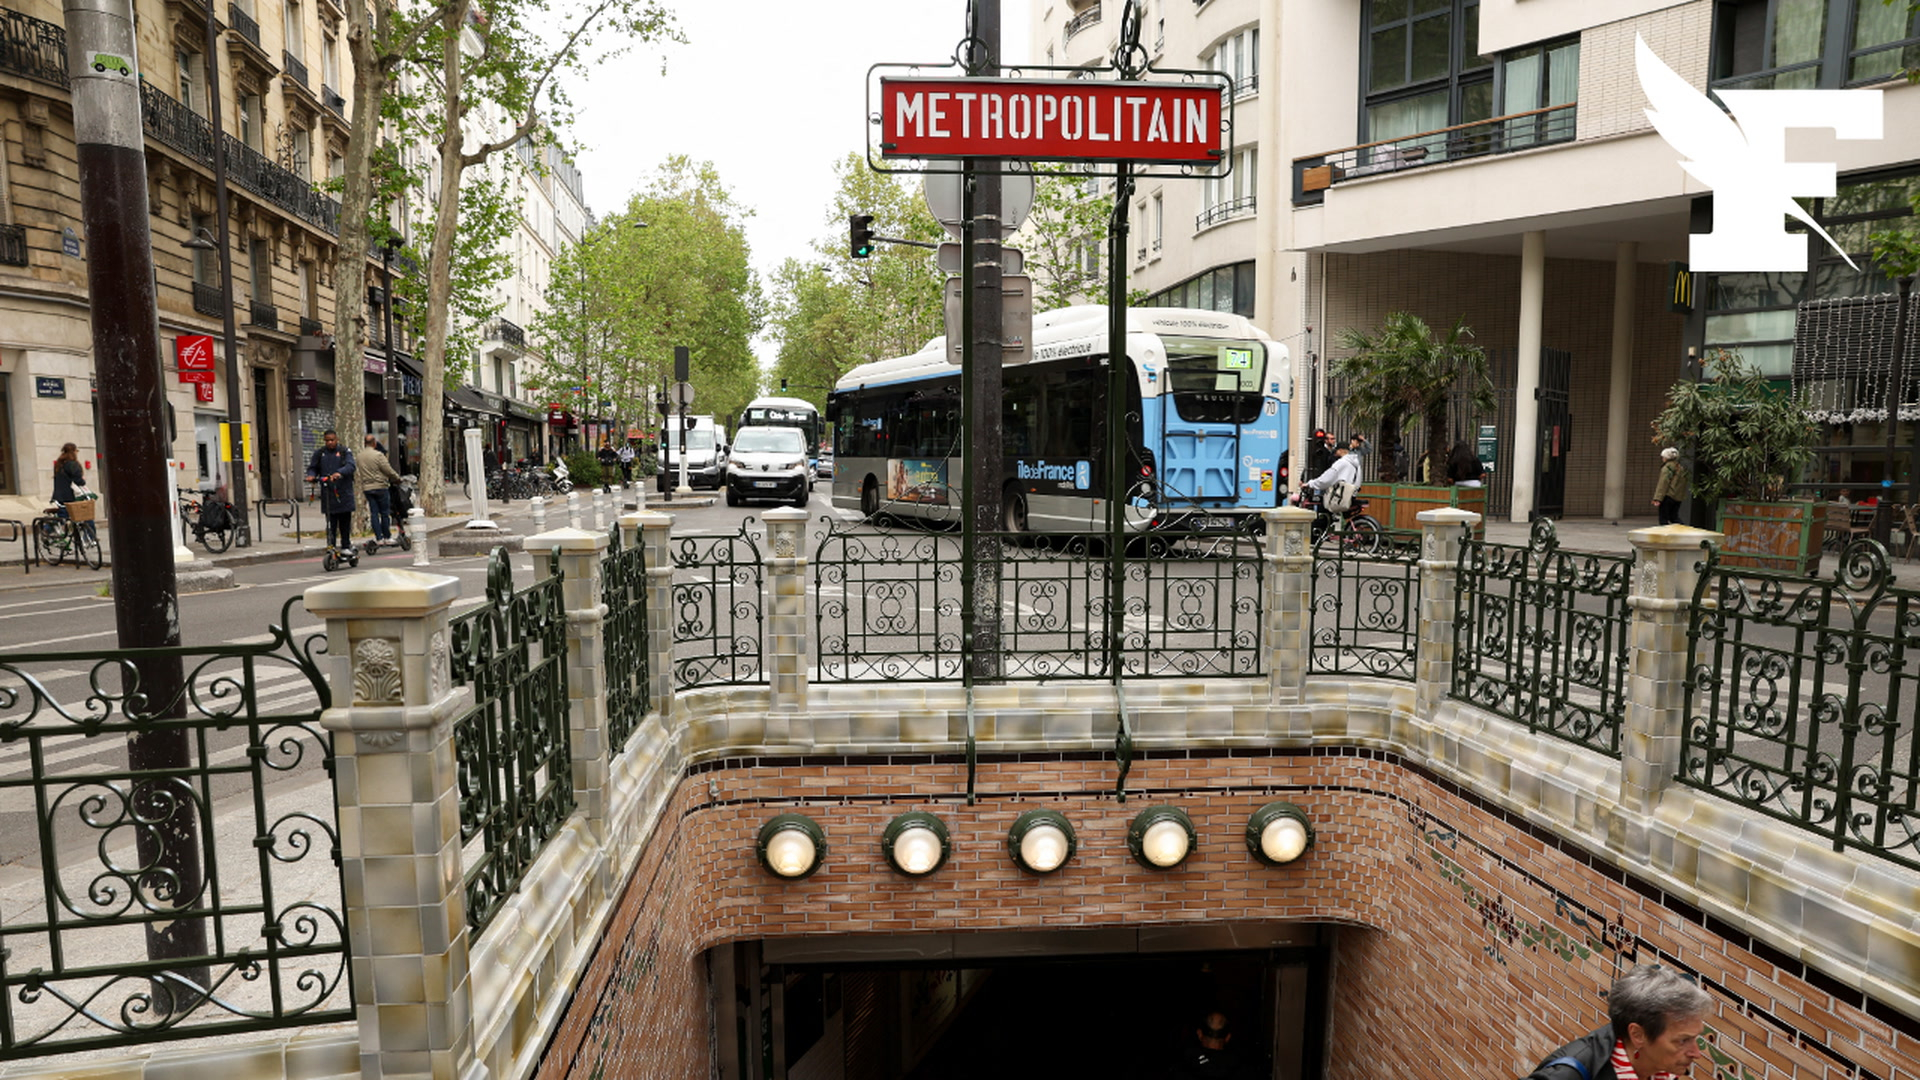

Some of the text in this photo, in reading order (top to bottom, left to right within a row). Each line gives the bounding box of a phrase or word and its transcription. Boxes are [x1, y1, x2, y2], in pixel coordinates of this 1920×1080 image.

[896, 91, 1208, 143] METROPOLITAIN
[1041, 347, 1056, 359] 100%
[1058, 342, 1092, 357] électrique
[1230, 352, 1247, 366] 74
[1266, 401, 1276, 415] 70
